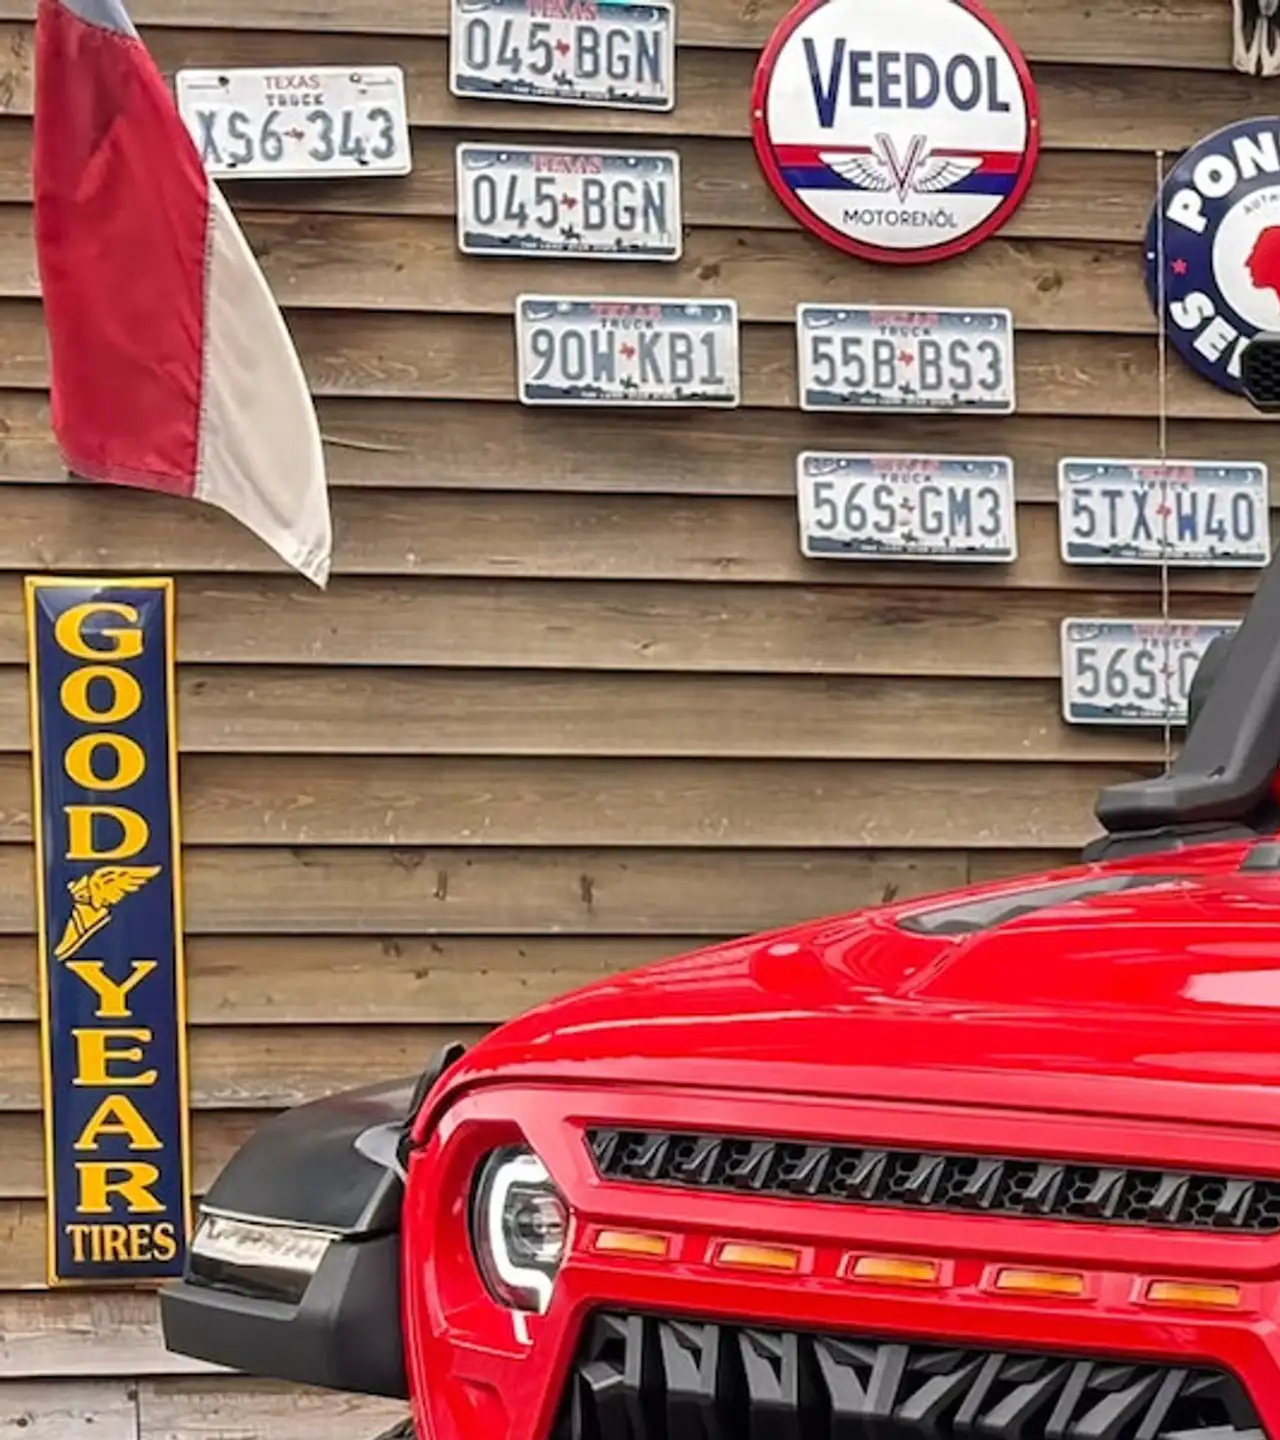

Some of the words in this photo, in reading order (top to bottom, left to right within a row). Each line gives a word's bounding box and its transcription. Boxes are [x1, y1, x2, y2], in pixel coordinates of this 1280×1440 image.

[264, 75, 321, 90] TEXAS
[802, 37, 1011, 128] VEEDOL
[842, 207, 959, 229] MOTORENÖL
[65, 1223, 176, 1263] TIRES
